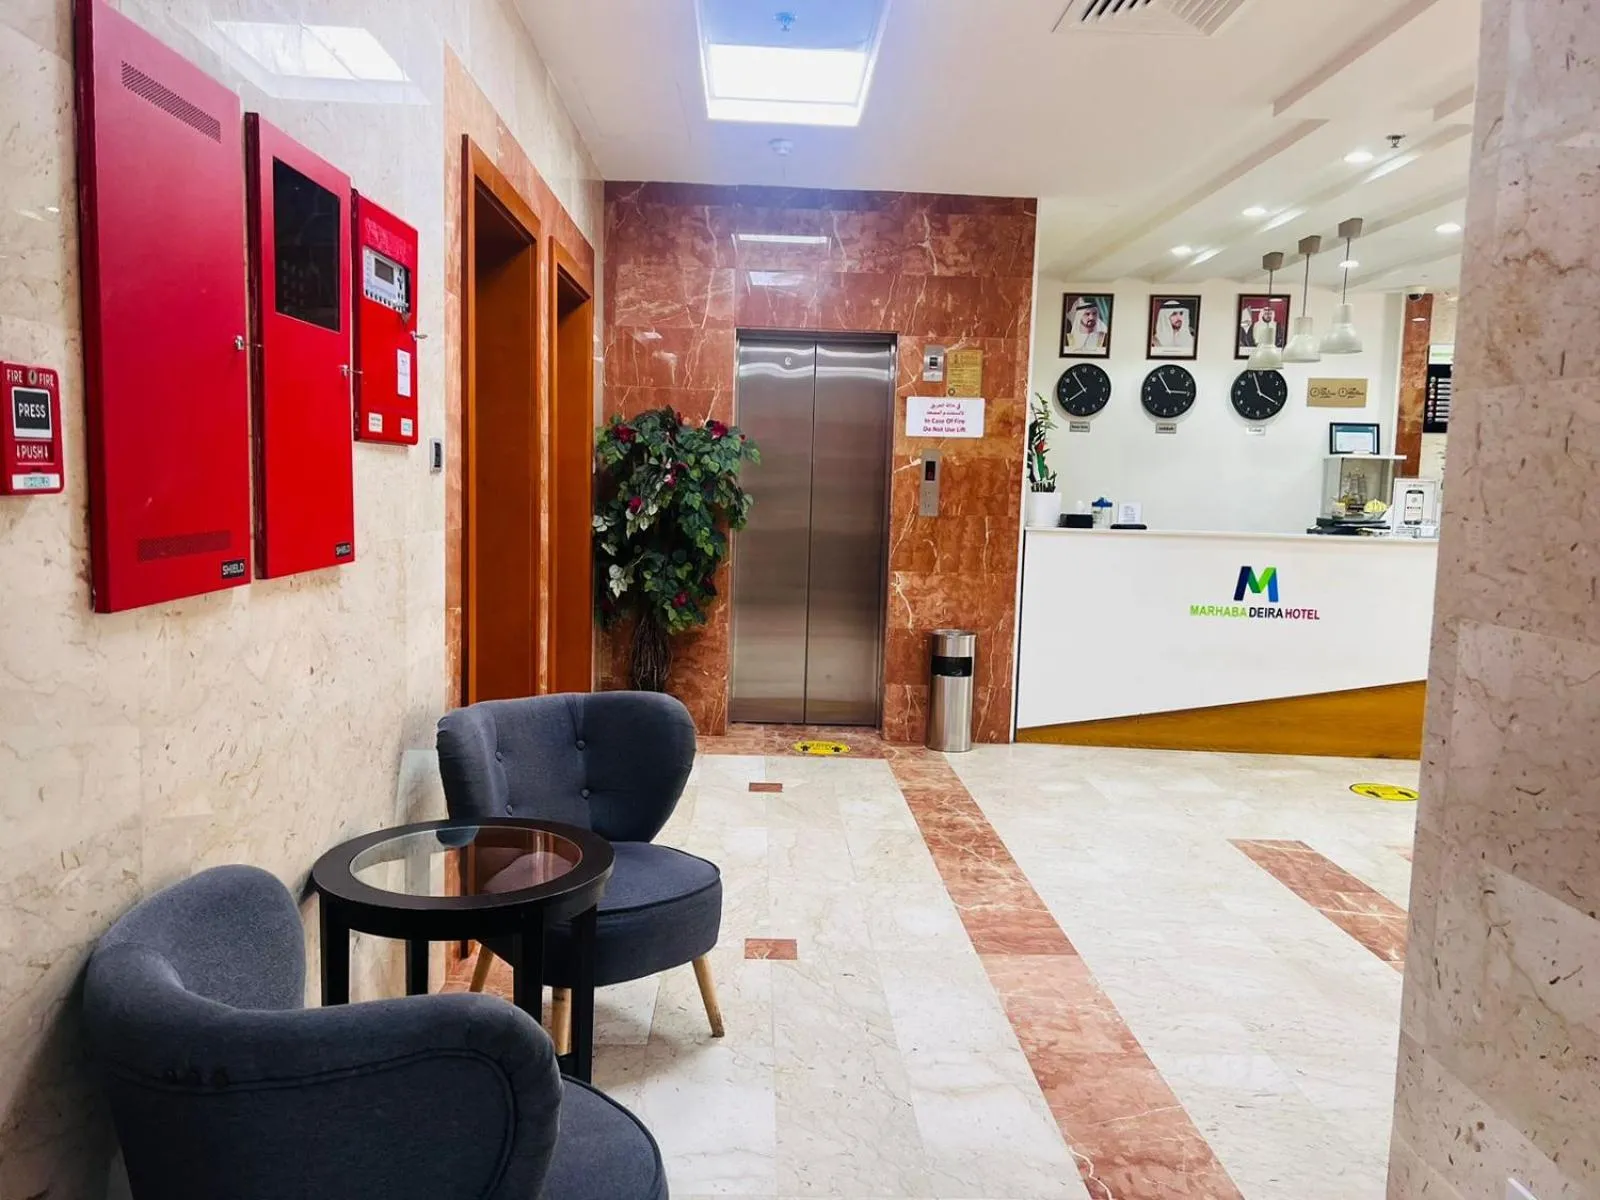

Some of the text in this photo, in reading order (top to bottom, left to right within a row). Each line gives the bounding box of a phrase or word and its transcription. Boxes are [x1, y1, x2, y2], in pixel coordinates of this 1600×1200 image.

[6, 369, 54, 387] FIRE FIRE
[18, 403, 46, 418] PRESS
[21, 445, 43, 459] PUSH
[222, 562, 245, 575] SHIELD
[1190, 604, 1320, 620] MARHABA DEIRA HOTEL
